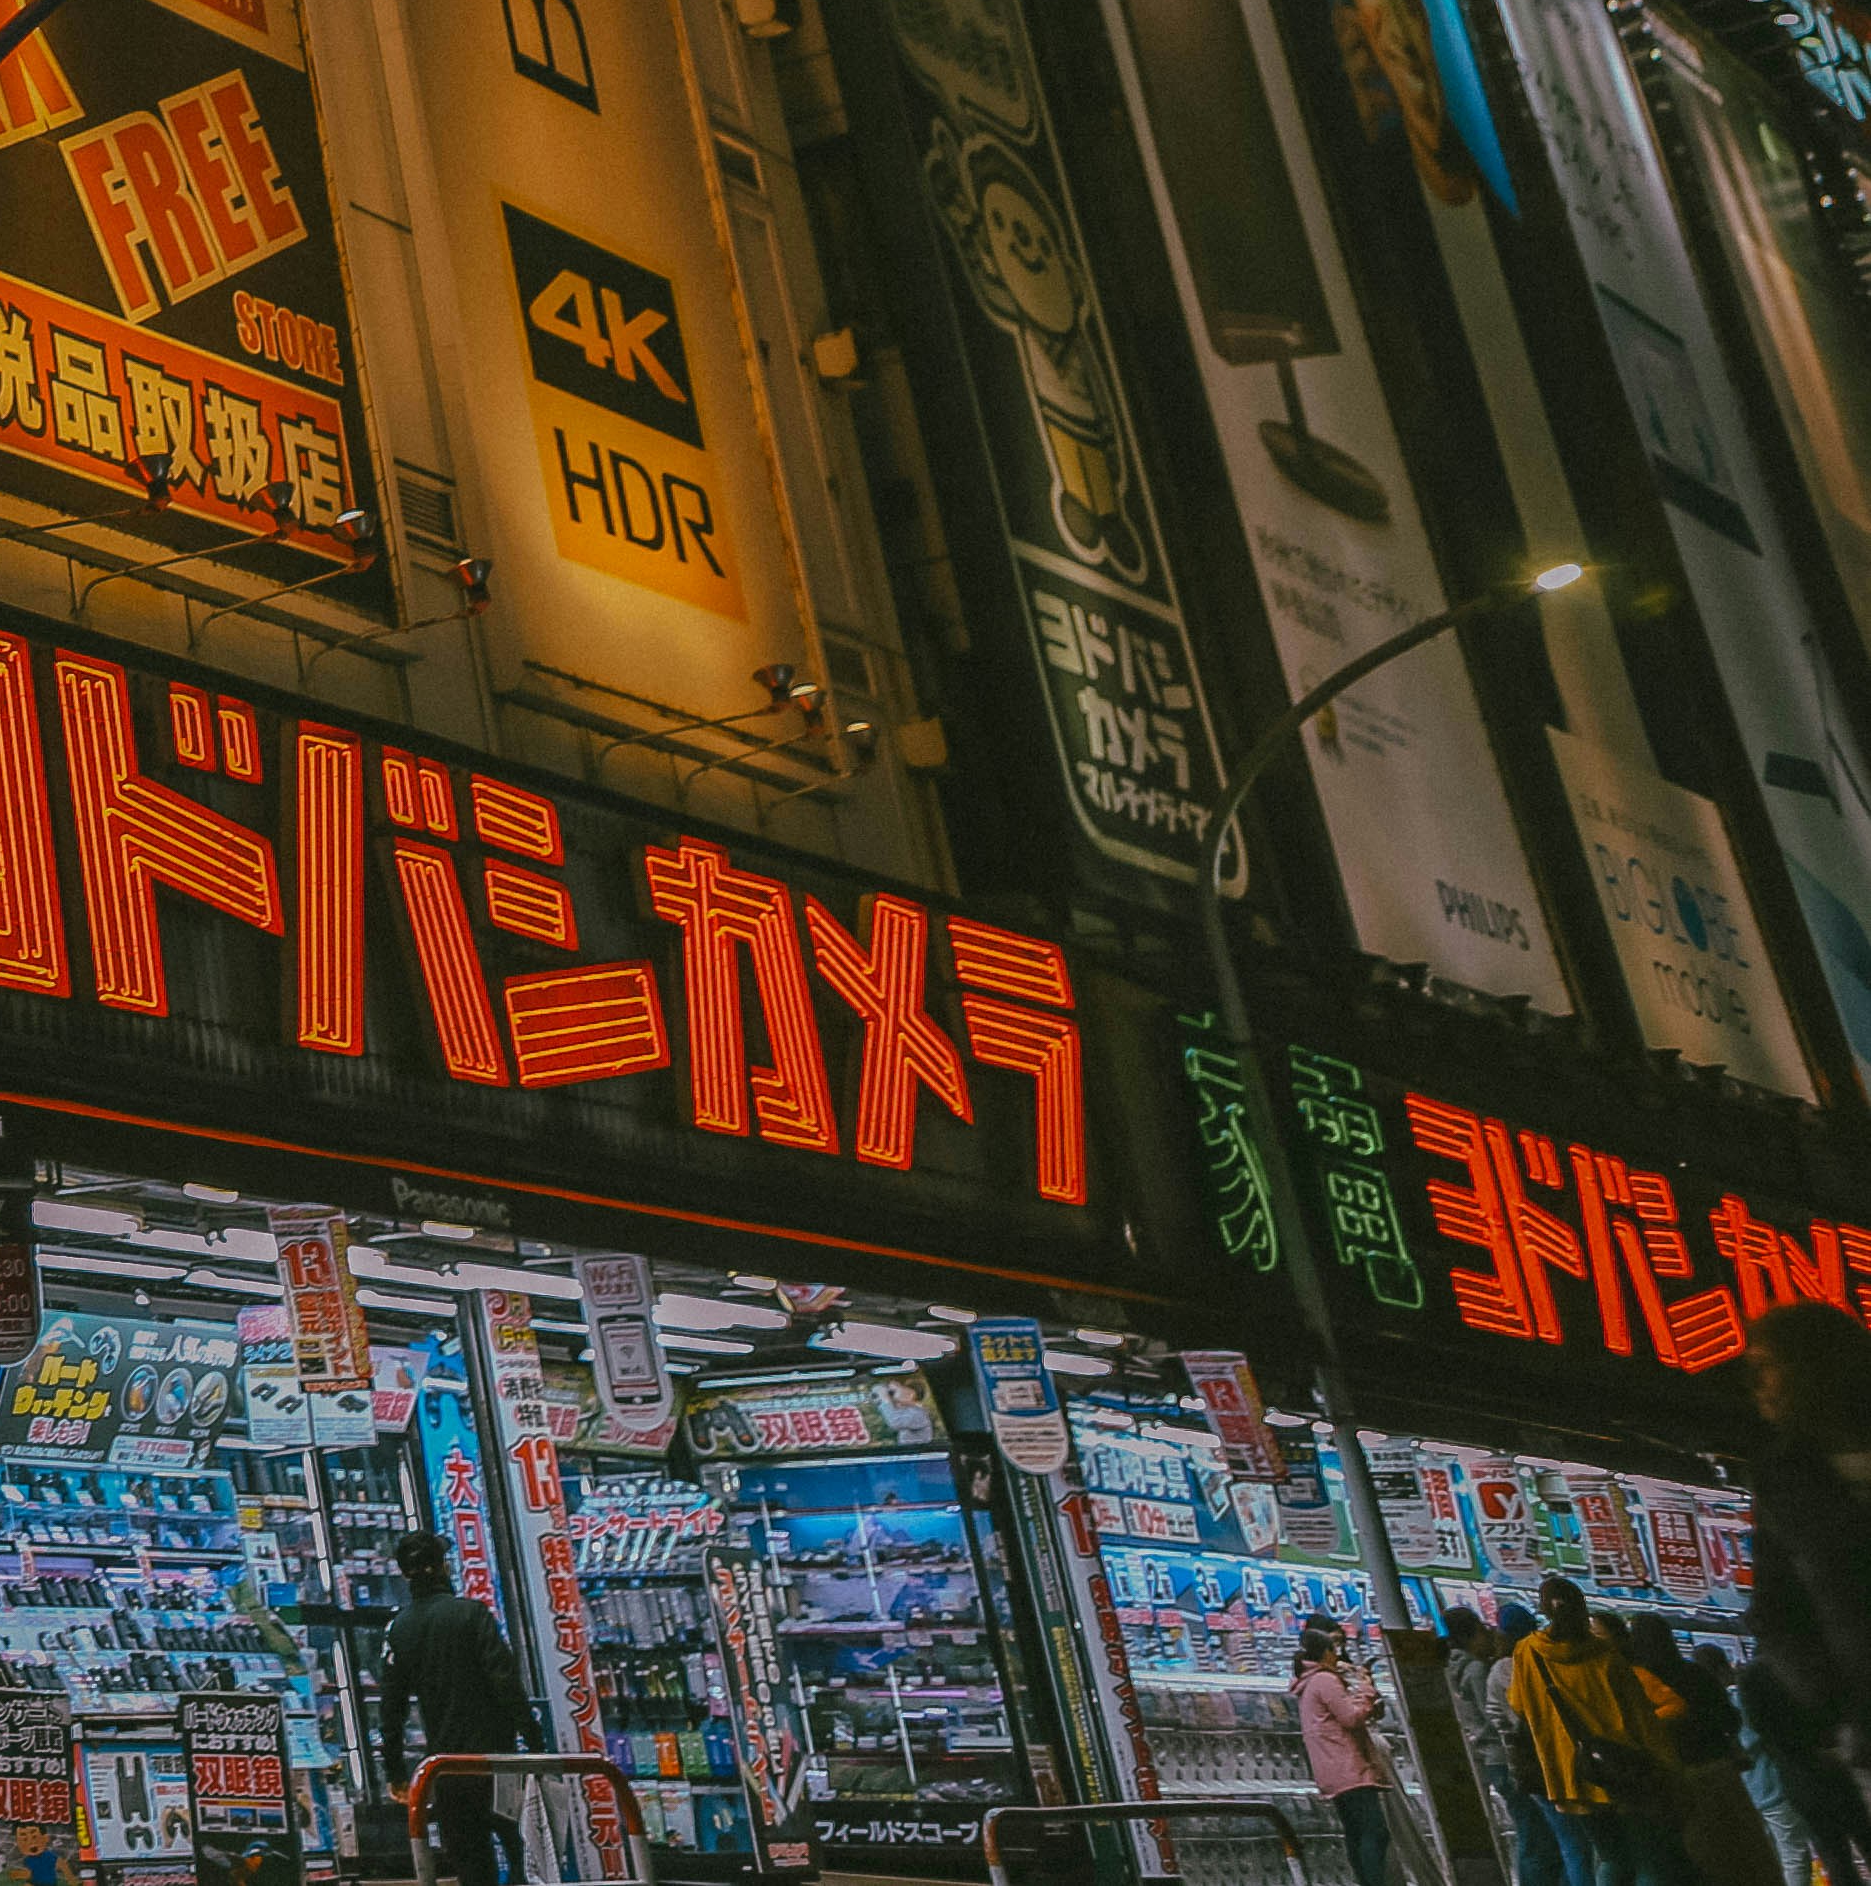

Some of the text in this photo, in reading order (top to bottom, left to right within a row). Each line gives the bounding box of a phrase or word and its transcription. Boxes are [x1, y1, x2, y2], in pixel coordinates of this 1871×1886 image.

[60, 69, 308, 326] FREE
[233, 288, 343, 385] STORE
[526, 265, 690, 407] 4K
[554, 422, 729, 579] HDR
[1033, 590, 1198, 713] ヨドバシ
[1077, 686, 1191, 791] カメラ
[1434, 876, 1532, 952] PHILIPS
[391, 1178, 512, 1228] Panasonic
[1404, 1090, 1871, 1378] ヨドバシカメ
[279, 1238, 334, 1289] 13
[754, 1406, 872, 1448] 双眼鏡
[190, 1732, 280, 1754] におすすめ!
[192, 1753, 286, 1800] 双眼鏡
[813, 1818, 981, 1846] フィールドスコープ
